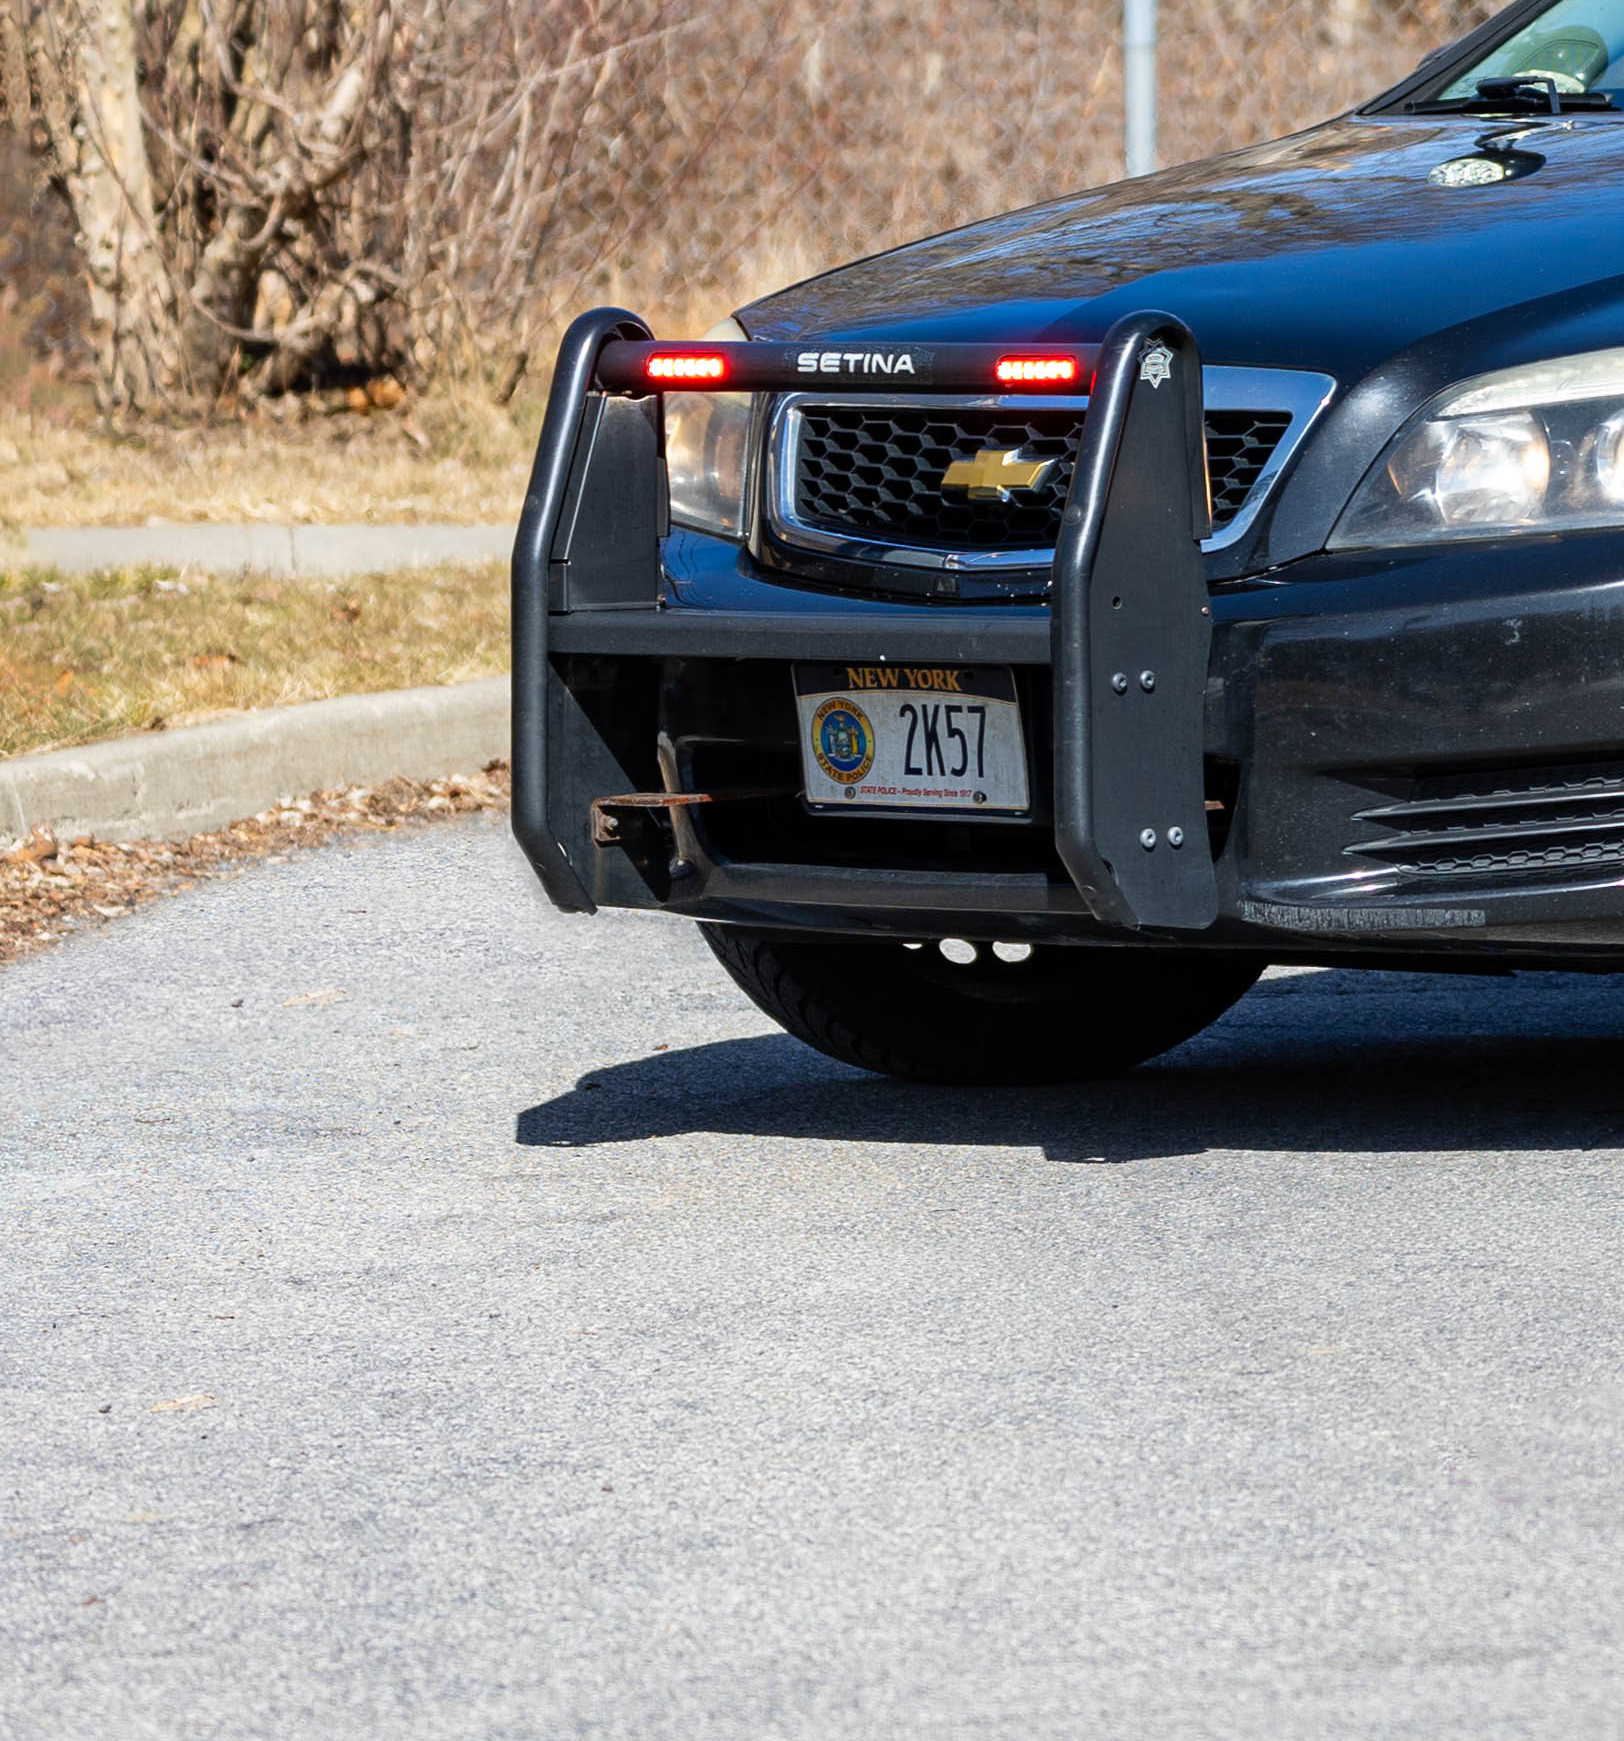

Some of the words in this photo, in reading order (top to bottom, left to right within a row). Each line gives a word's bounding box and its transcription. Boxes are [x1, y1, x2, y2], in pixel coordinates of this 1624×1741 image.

[796, 351, 917, 375] SETINA
[846, 667, 899, 689] NEW
[904, 668, 962, 692] YORK
[899, 703, 987, 779] 2K57
[816, 752, 845, 782] STATE
[846, 753, 875, 782] POLICE
[878, 786, 897, 795] POLICE
